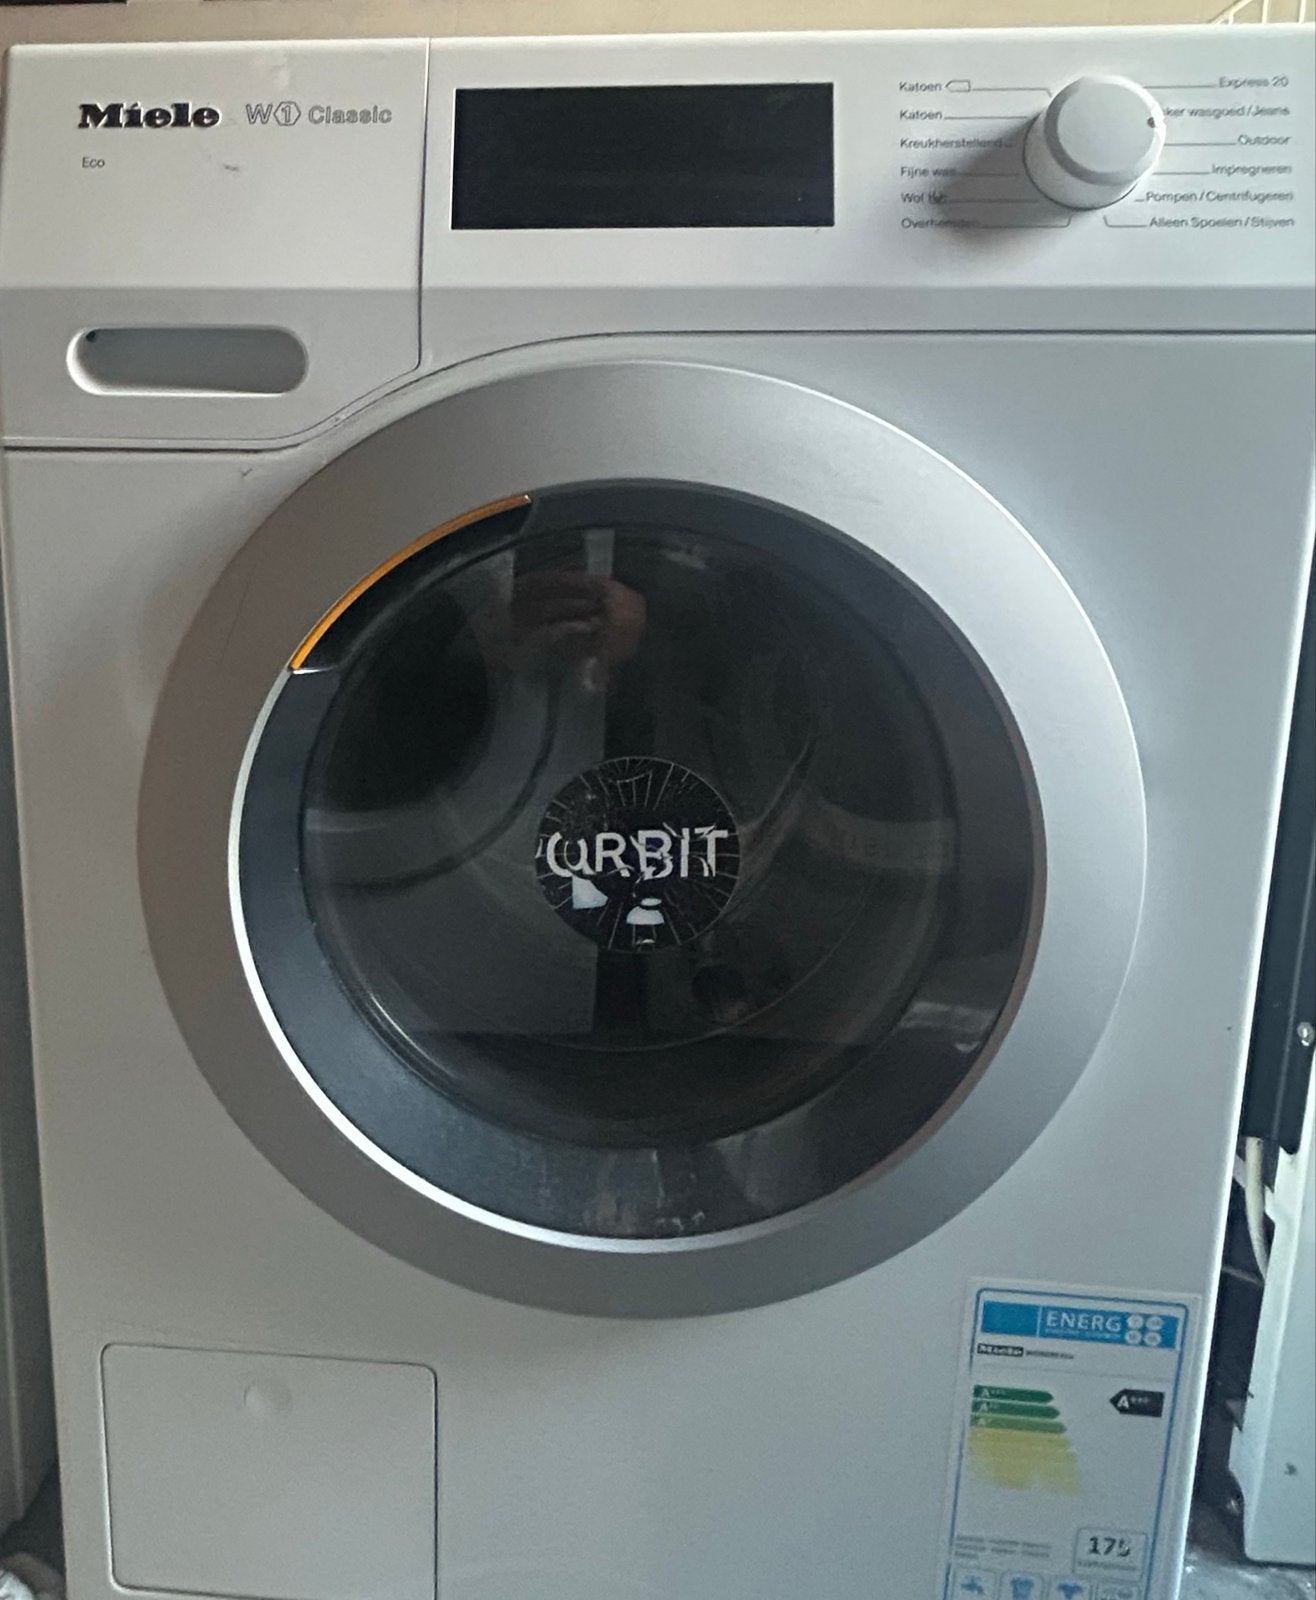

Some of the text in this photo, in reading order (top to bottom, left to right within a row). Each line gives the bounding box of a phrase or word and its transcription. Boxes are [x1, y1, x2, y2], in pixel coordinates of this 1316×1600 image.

[900, 82, 942, 92] Katoen
[1219, 75, 1289, 89] Express 20
[78, 102, 221, 129] Miele
[308, 105, 392, 124] Classic
[900, 110, 943, 120] Katoen
[1238, 134, 1291, 145] Outdoor
[82, 156, 105, 168] Eco
[901, 165, 929, 179] Fijne
[1212, 163, 1292, 176] Impregneren
[901, 192, 924, 203] Wol
[1150, 216, 1188, 228] Alleen
[1046, 1309, 1122, 1333] ENERG
